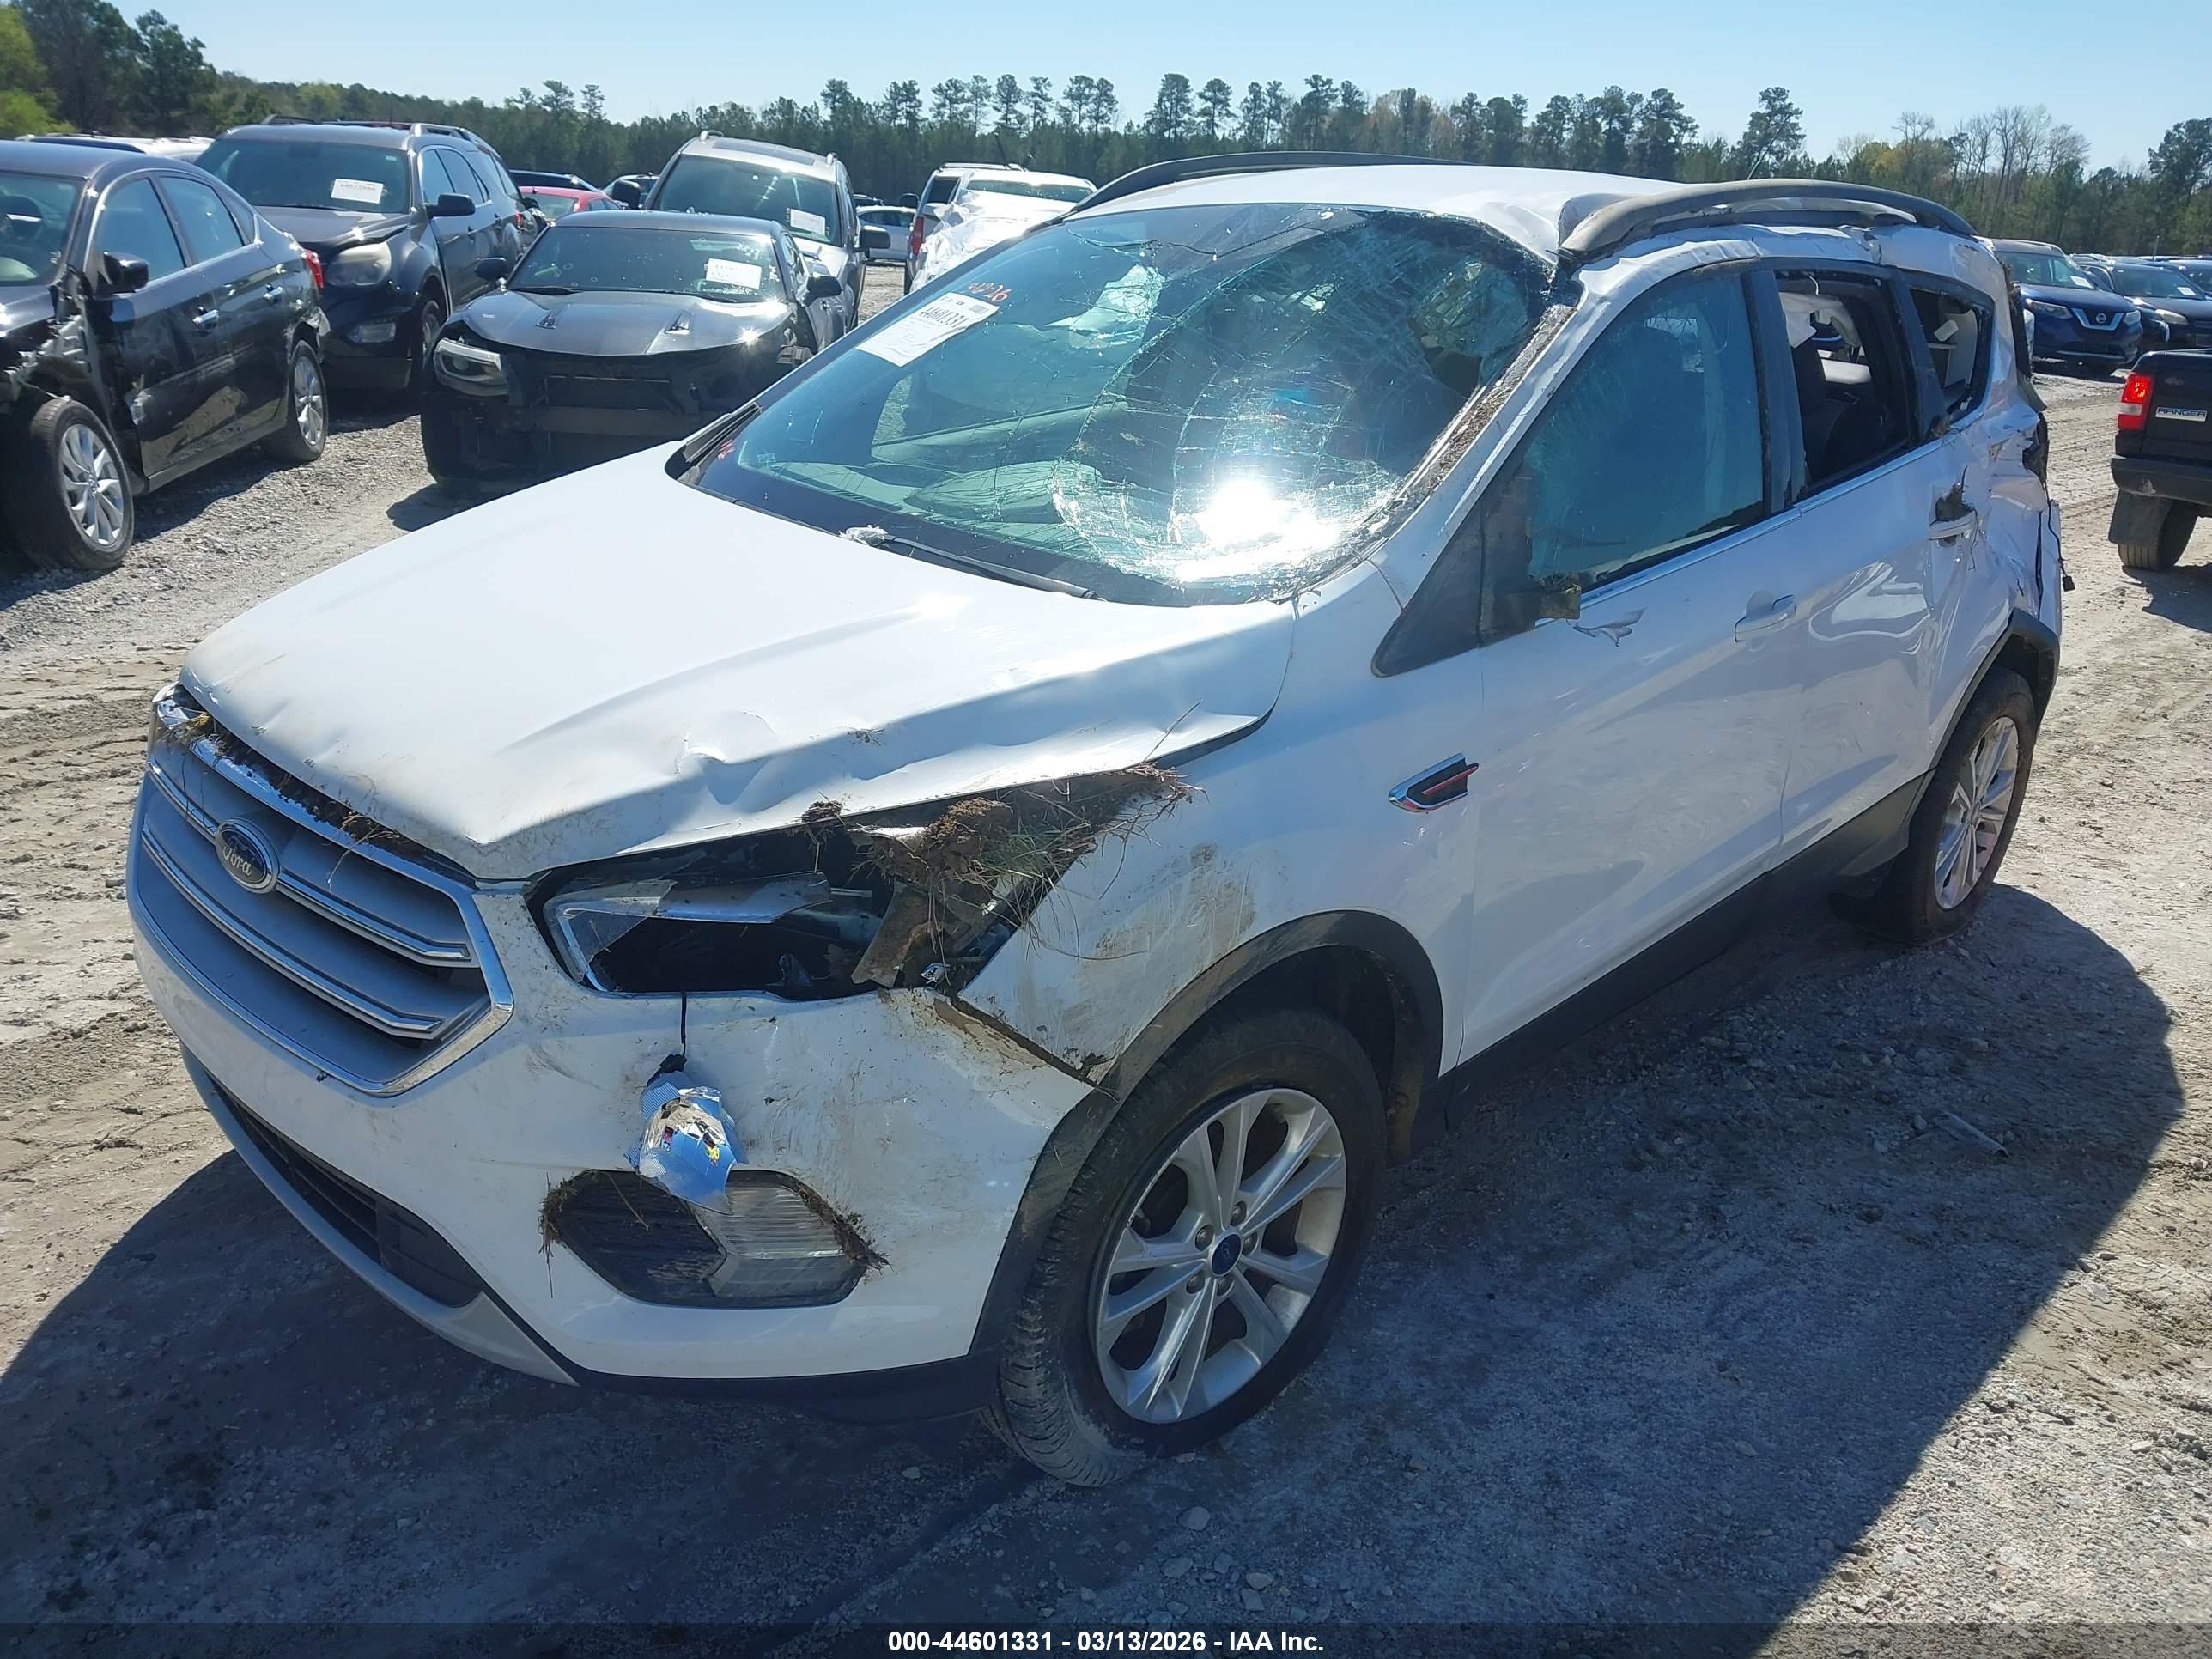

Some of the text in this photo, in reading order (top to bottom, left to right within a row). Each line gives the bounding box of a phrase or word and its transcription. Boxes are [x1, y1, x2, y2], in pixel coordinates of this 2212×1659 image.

[920, 306, 969, 328] 44601331
[2157, 407, 2207, 418] RANGER
[222, 838, 255, 876] Ford
